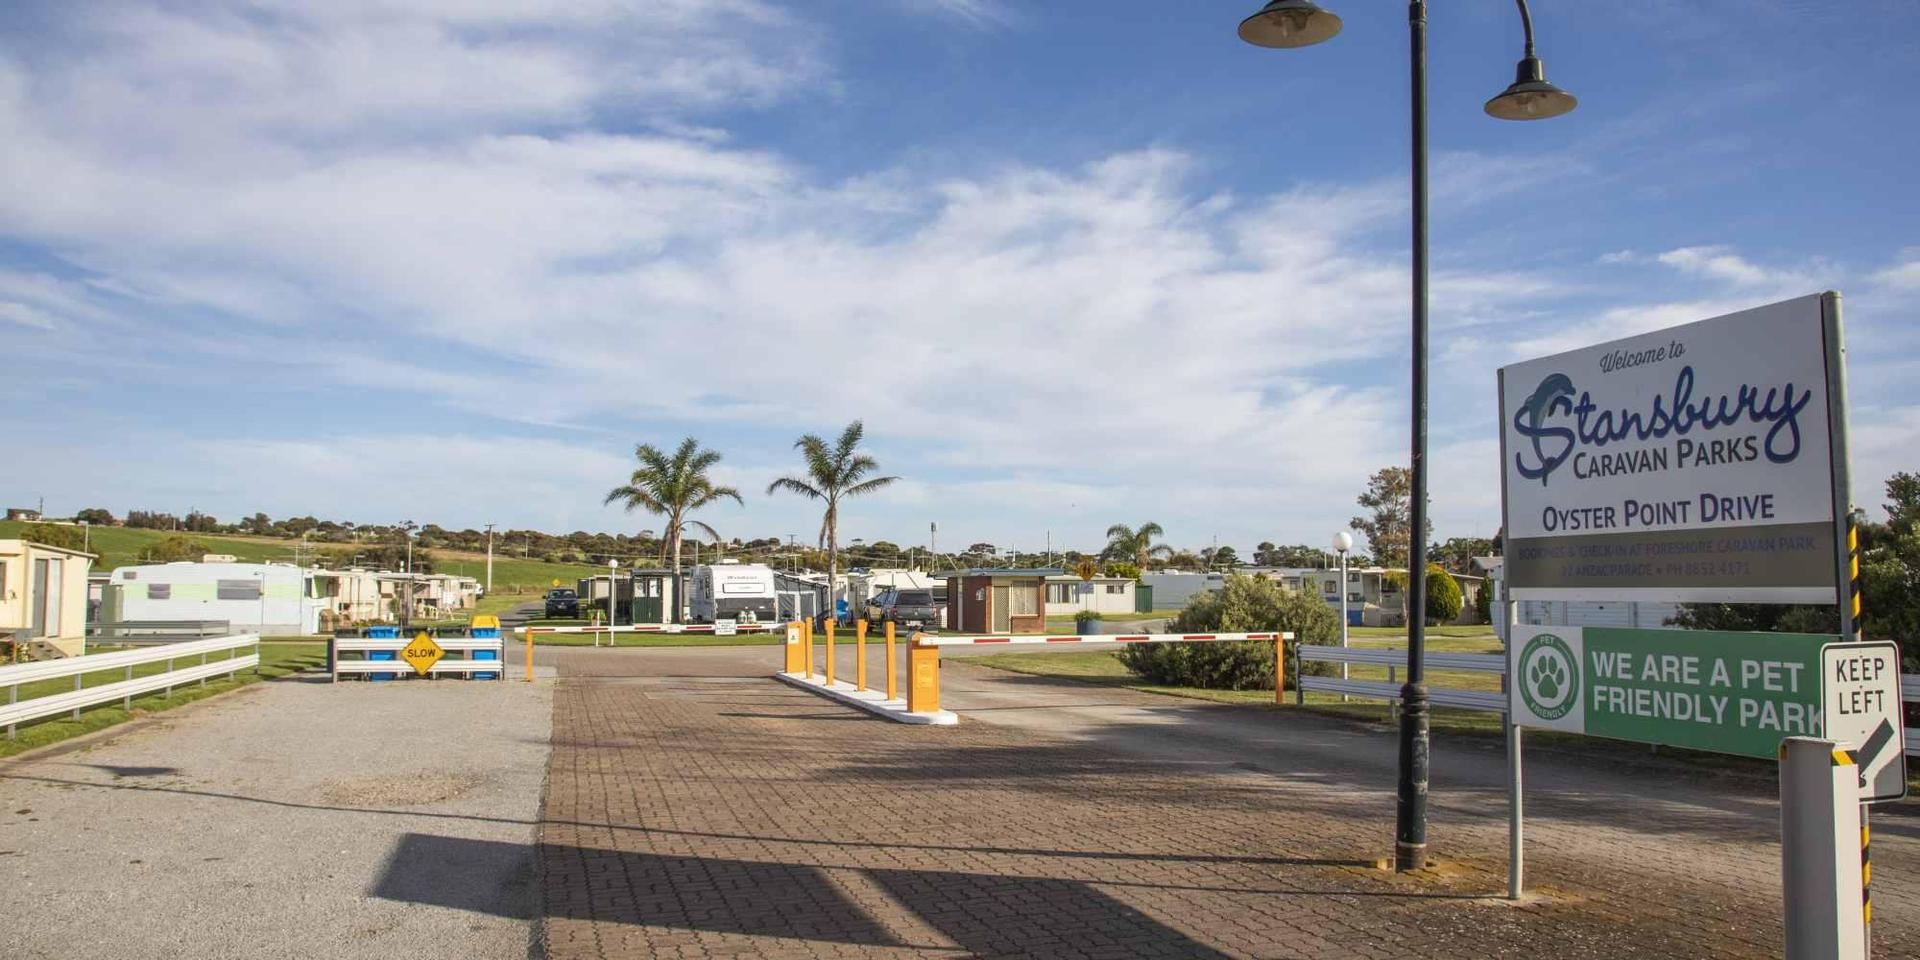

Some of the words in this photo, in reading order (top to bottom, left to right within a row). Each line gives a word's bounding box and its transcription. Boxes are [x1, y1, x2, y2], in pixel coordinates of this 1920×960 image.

[1600, 346, 1665, 373] Welcome
[1668, 340, 1685, 359] to
[1514, 366, 1811, 480] Stansbury
[1574, 447, 1668, 479] CARAVAN
[1677, 436, 1758, 468] PARKS
[1543, 506, 1616, 531] OYSTER
[1624, 500, 1691, 526] POINT
[1700, 493, 1774, 522] DRIVE
[1718, 536, 1775, 553] CARAVAN
[1779, 536, 1816, 551] PARK
[1611, 563, 1653, 576] PARADE
[407, 648, 436, 658] SLOW
[1540, 635, 1554, 645] PET
[1592, 651, 1632, 680] WE
[1641, 654, 1700, 685] ARE
[1709, 658, 1731, 687] A
[1741, 660, 1804, 693] PET
[1836, 658, 1884, 682] KEEP
[1593, 685, 1728, 725] FRIENDLY
[1740, 698, 1821, 735] PARK
[1839, 689, 1884, 715] LEFT
